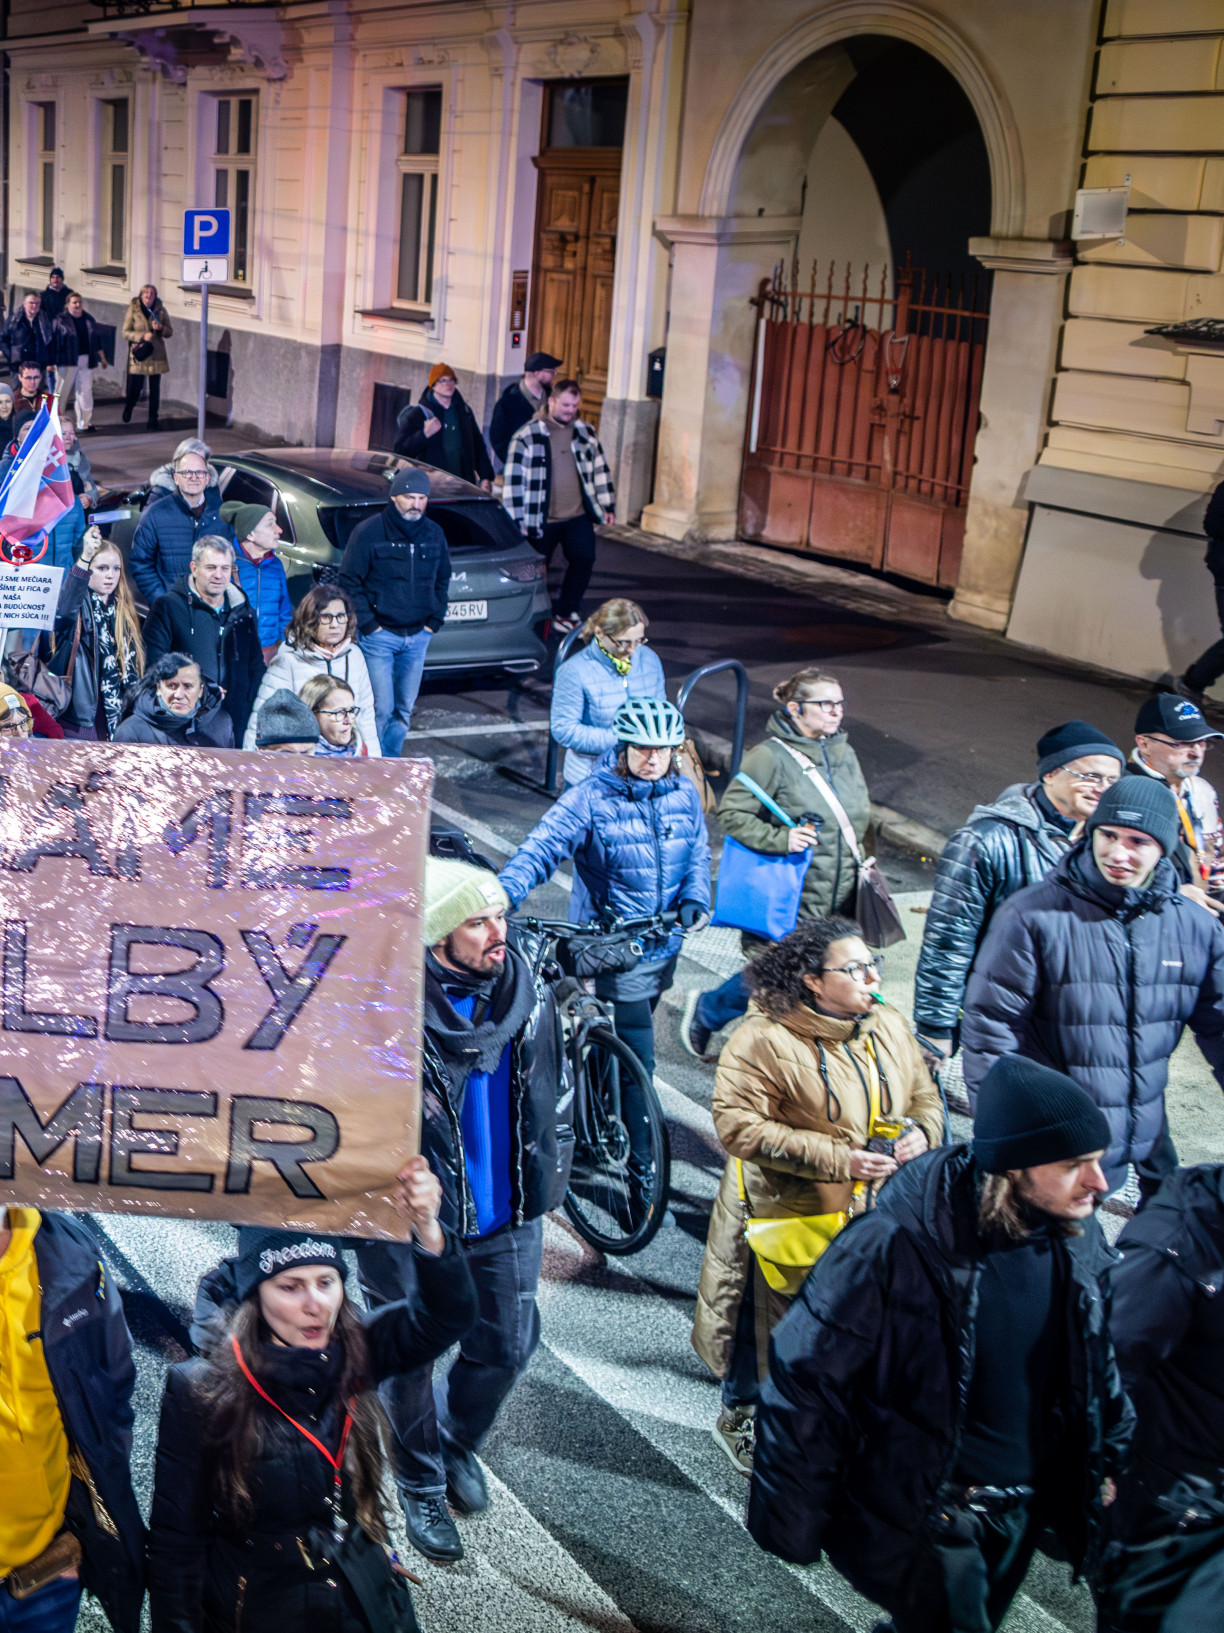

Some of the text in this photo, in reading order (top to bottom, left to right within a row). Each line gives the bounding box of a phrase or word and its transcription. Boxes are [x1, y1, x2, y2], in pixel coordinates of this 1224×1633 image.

[193, 214, 219, 250] P
[21, 576, 52, 584] MEČIARA
[259, 1237, 337, 1274] Freedom
